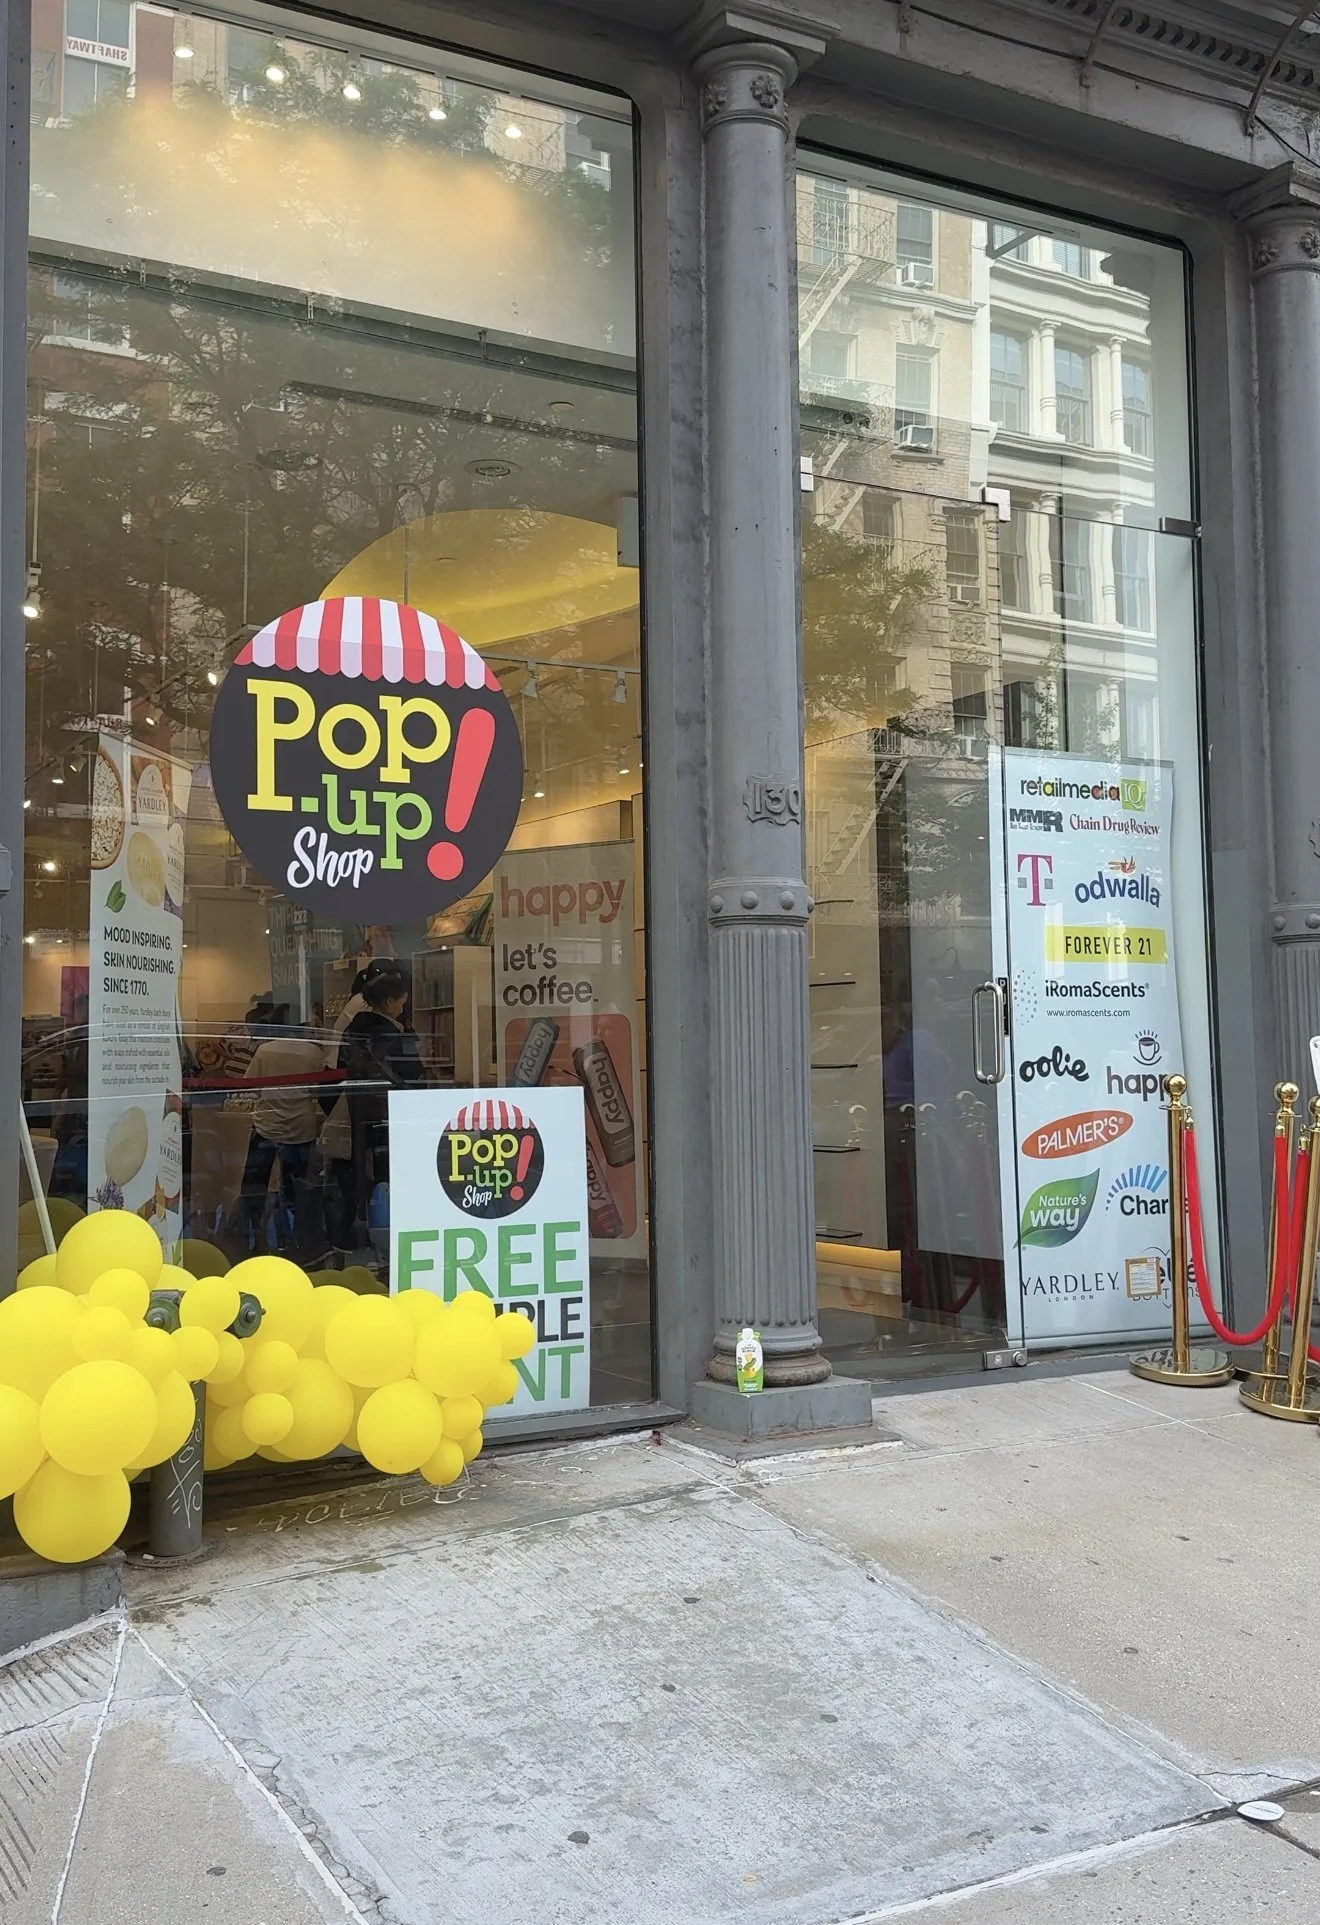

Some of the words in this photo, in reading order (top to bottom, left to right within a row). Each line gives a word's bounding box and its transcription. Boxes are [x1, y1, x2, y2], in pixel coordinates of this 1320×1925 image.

[138, 797, 167, 812] YARDLEY
[1009, 808, 1063, 832] MMR
[1069, 813, 1100, 831] Chain
[1102, 815, 1130, 834] Drug
[1130, 817, 1160, 835] Review
[286, 826, 374, 888] Shop
[501, 876, 626, 926] happy
[1074, 870, 1160, 908] odwalla
[104, 926, 130, 944] MOOD
[132, 930, 173, 951] INSPIRING.
[1065, 936, 1132, 955] FOREVER
[1138, 938, 1152, 955] 21
[103, 951, 125, 968] SKIN
[126, 954, 176, 975] NOURISHING.
[103, 977, 128, 994] SINCE
[130, 980, 150, 996] 1770.
[503, 975, 599, 1006] coffee.
[1046, 1008, 1131, 1017] www.iromascents.com
[1019, 1045, 1090, 1082] oolie
[592, 1056, 625, 1124] happy
[1106, 1066, 1168, 1101] happ
[462, 1184, 493, 1208] Shop
[1039, 1193, 1088, 1207] Nature's
[1120, 1195, 1169, 1216] Char
[1029, 1207, 1080, 1231] way
[398, 1221, 584, 1302] FREE
[1048, 1294, 1094, 1303] LONDON
